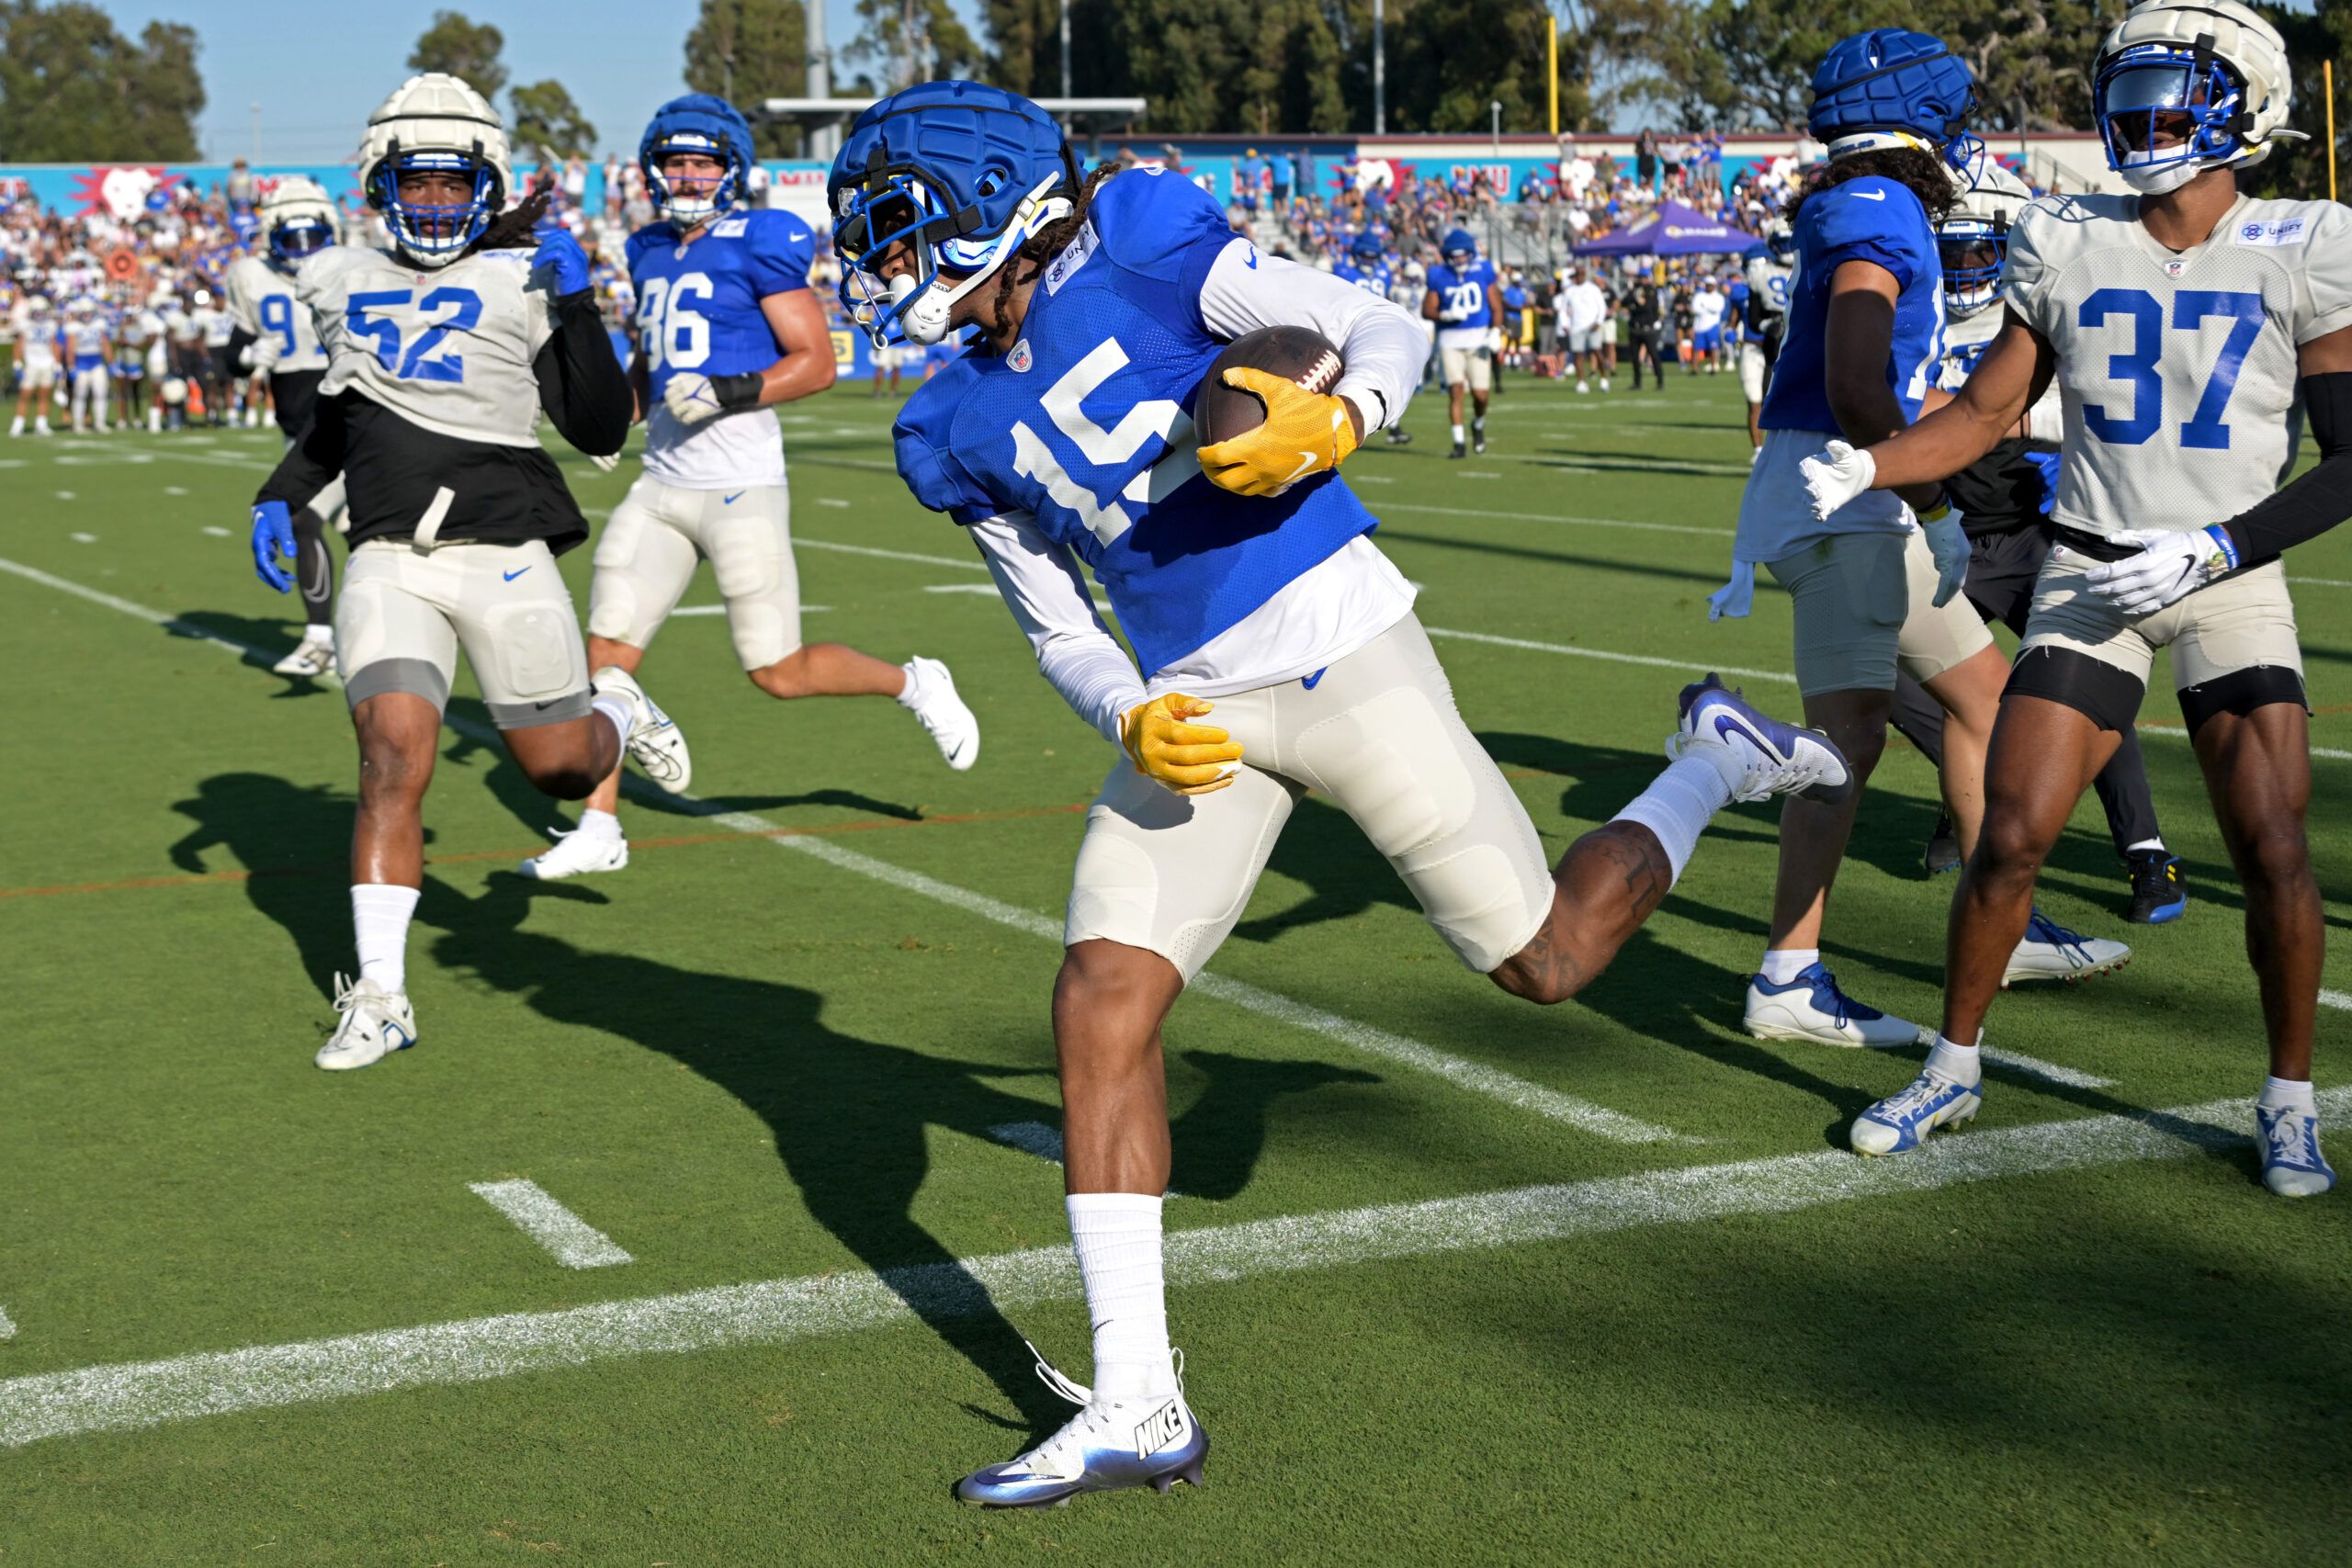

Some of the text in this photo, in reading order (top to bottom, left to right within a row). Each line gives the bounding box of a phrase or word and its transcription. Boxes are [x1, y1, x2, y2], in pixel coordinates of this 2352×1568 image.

[1068, 227, 1091, 260] UNFY
[2268, 223, 2302, 235] UNIFY
[345, 287, 483, 382] 52
[636, 272, 714, 371] 86
[2078, 288, 2267, 450] 37
[1010, 336, 1202, 548] 15
[1135, 1399, 1183, 1461] NIKE
